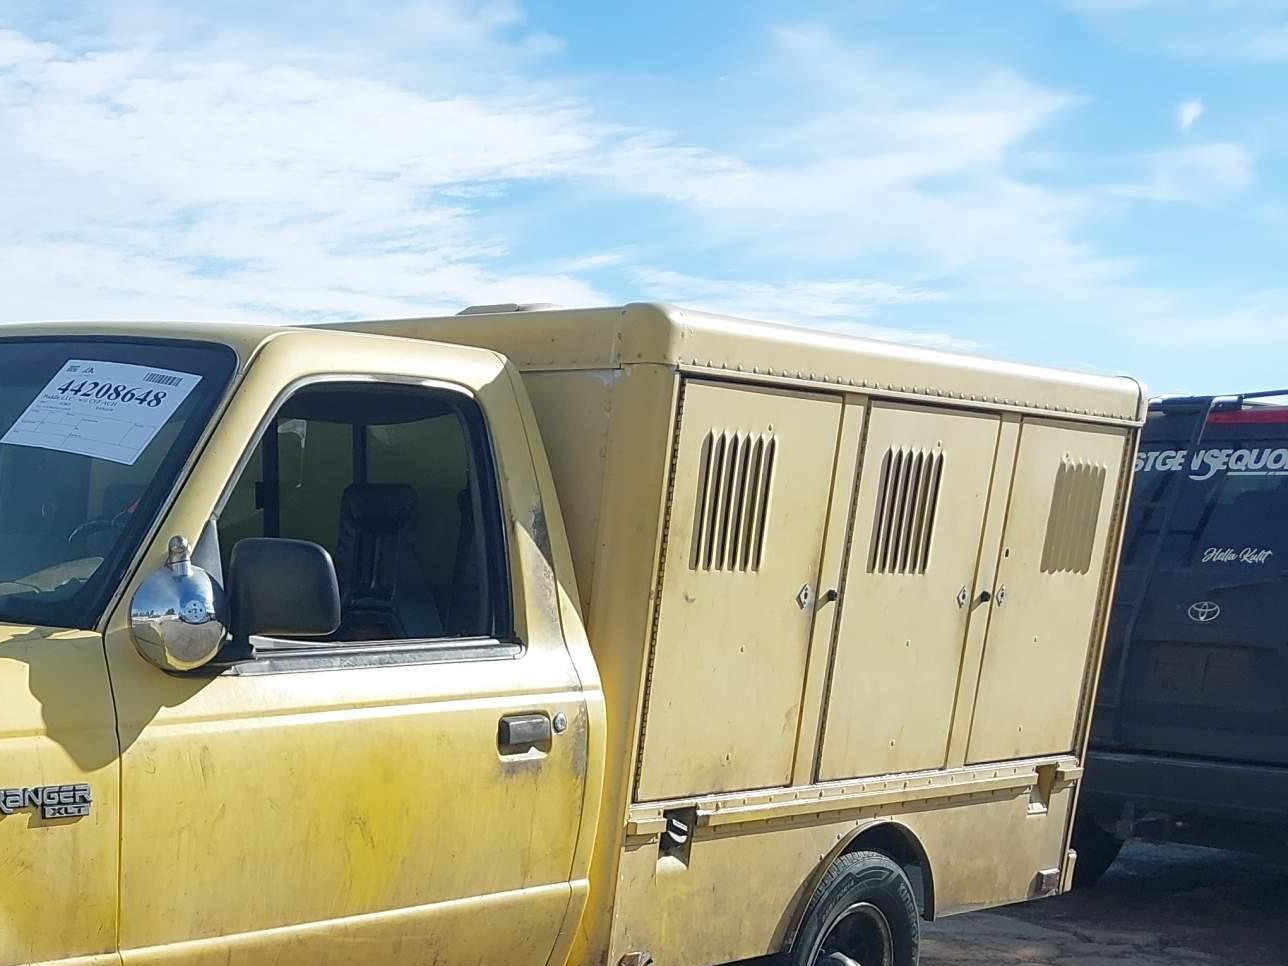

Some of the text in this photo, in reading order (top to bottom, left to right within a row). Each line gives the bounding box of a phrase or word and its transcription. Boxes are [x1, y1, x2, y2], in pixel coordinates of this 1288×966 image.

[57, 379, 167, 408] 44208648
[1201, 547, 1238, 563] Hella
[50, 806, 86, 816] XLT
